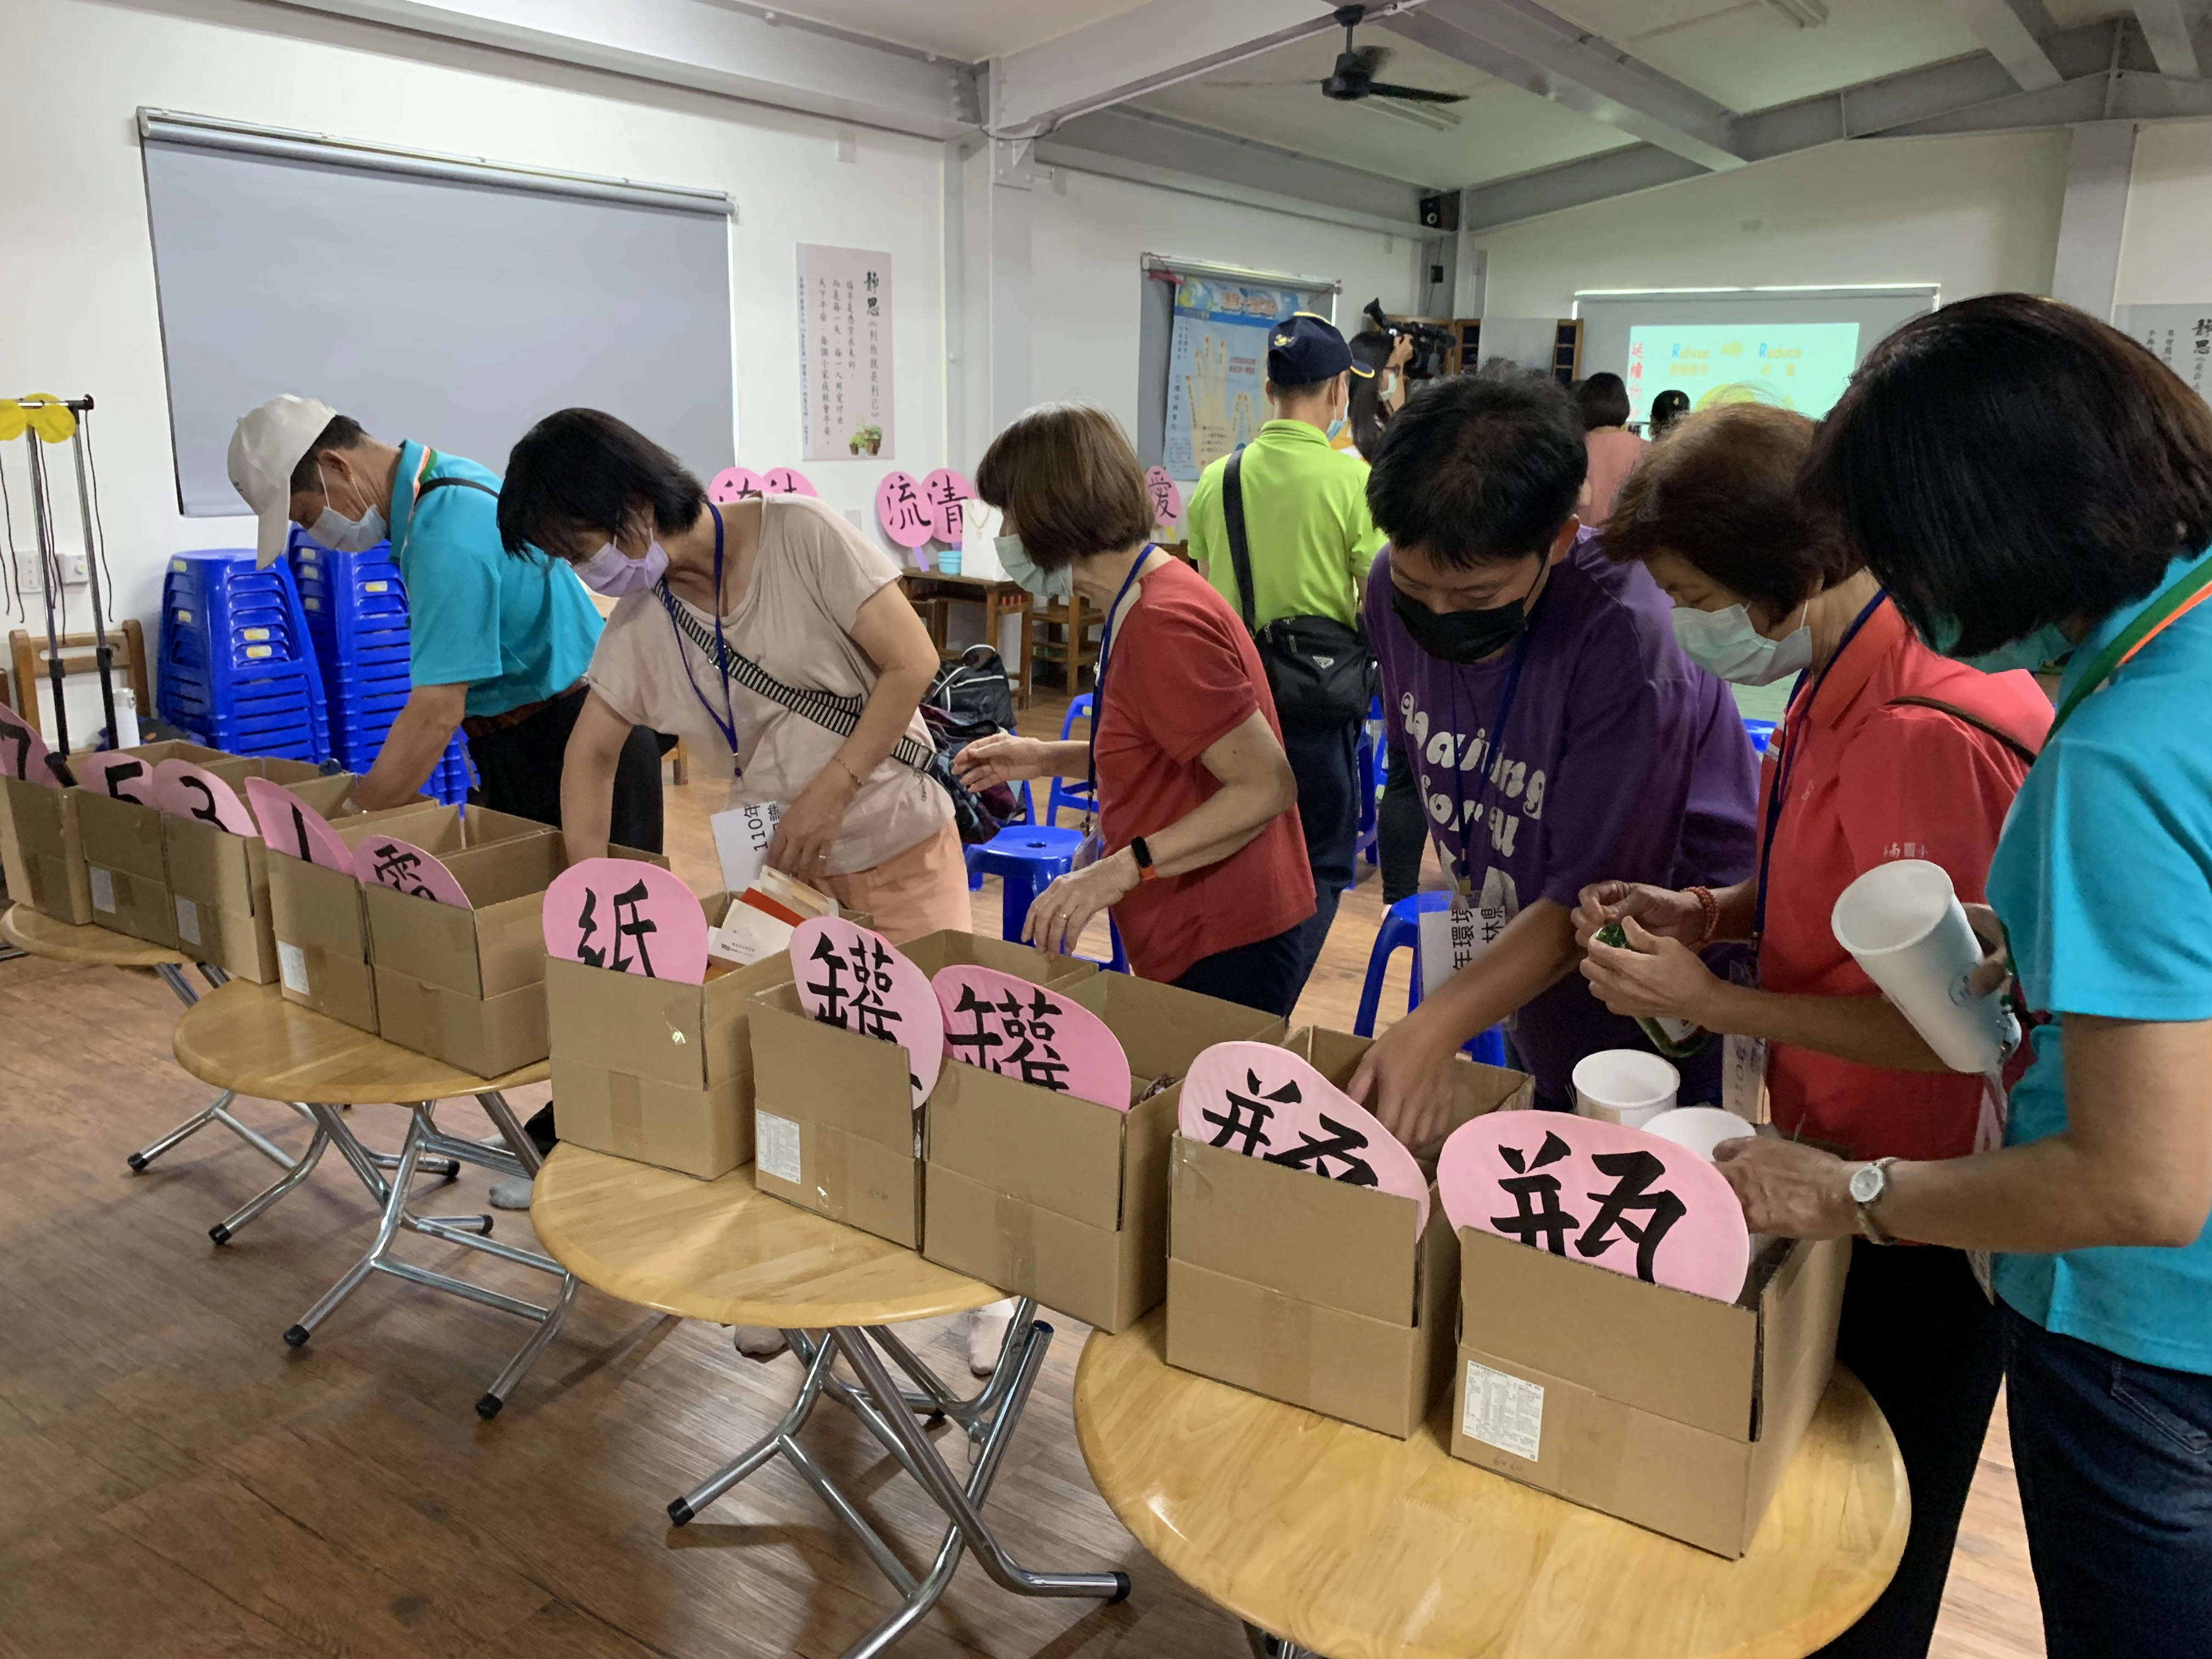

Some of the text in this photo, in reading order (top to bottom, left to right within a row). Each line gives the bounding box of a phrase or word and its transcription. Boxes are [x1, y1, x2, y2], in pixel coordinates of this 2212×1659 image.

[887, 475, 932, 530] 流
[1148, 467, 1177, 519] 愛
[104, 760, 144, 806] 5
[743, 804, 769, 852] 110年
[577, 878, 658, 979] 紙
[806, 932, 917, 1067] 罐
[944, 983, 1071, 1093] 罐
[1489, 1129, 1688, 1285] 瓶
